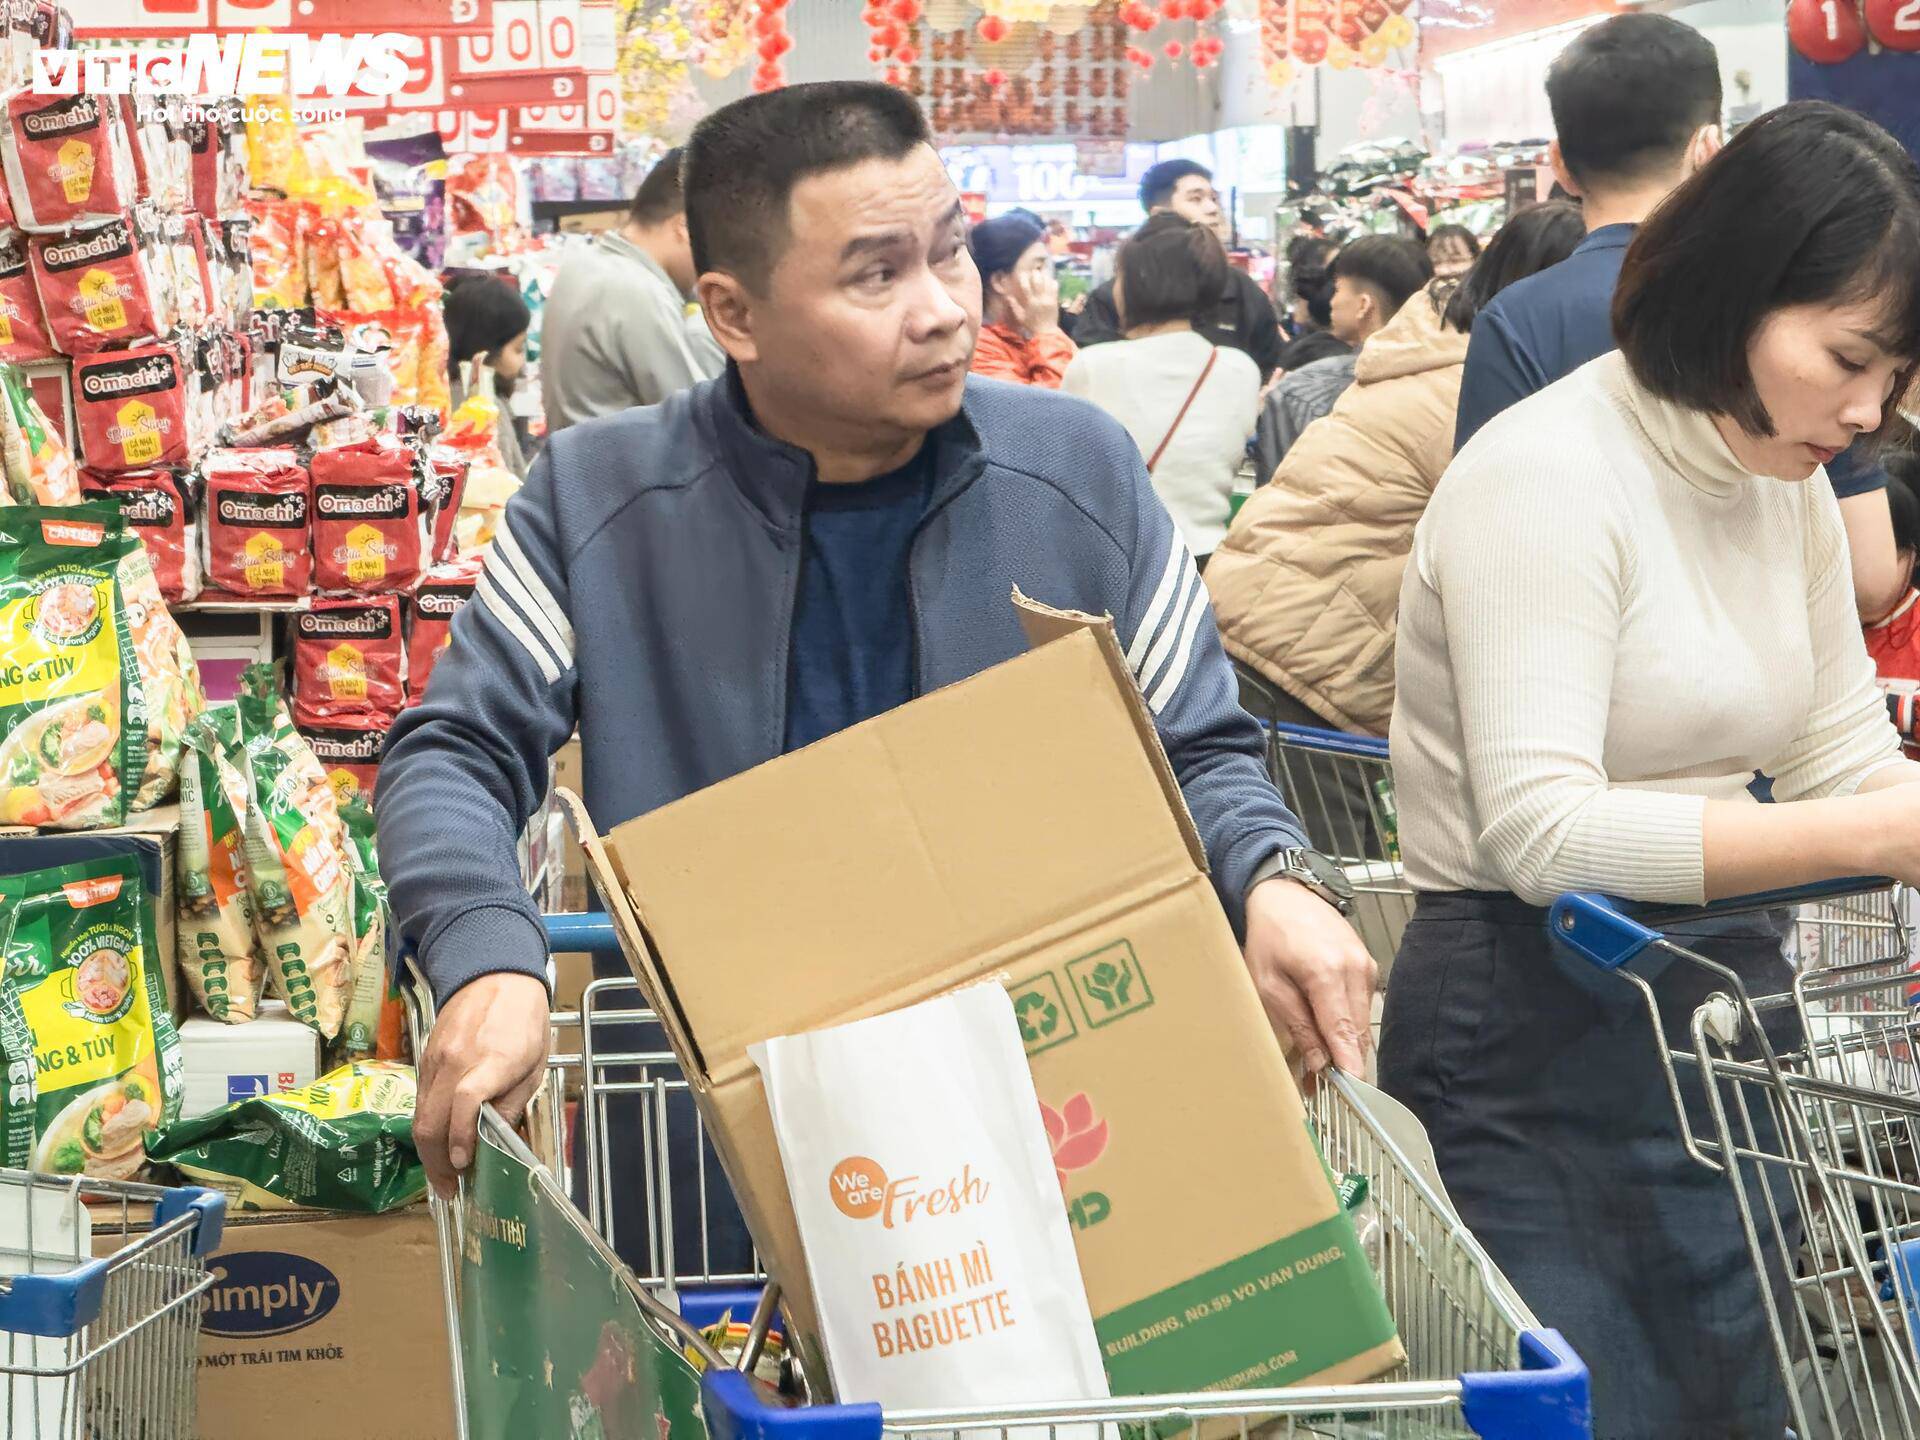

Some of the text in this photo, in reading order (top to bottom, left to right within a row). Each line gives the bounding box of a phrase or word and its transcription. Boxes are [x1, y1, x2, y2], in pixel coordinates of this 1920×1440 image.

[25, 103, 96, 133] Omachi
[44, 232, 120, 266] Omachi
[84, 366, 163, 394] Omachi
[119, 499, 158, 521] achi
[220, 500, 295, 522] Omachi
[318, 493, 394, 513] Omachi
[419, 592, 467, 613] Oma
[300, 613, 377, 634] Omachi
[67, 938, 97, 967] 100%
[65, 1045, 82, 1066] &
[834, 1170, 870, 1193] We
[847, 1163, 991, 1230] are Fresh
[872, 1239, 994, 1310] BÁNH MÌ
[1257, 1265, 1294, 1291] VAN
[871, 1289, 1017, 1358] BAGUETTE
[240, 1348, 273, 1365] TRÁI
[276, 1350, 301, 1363] TIM
